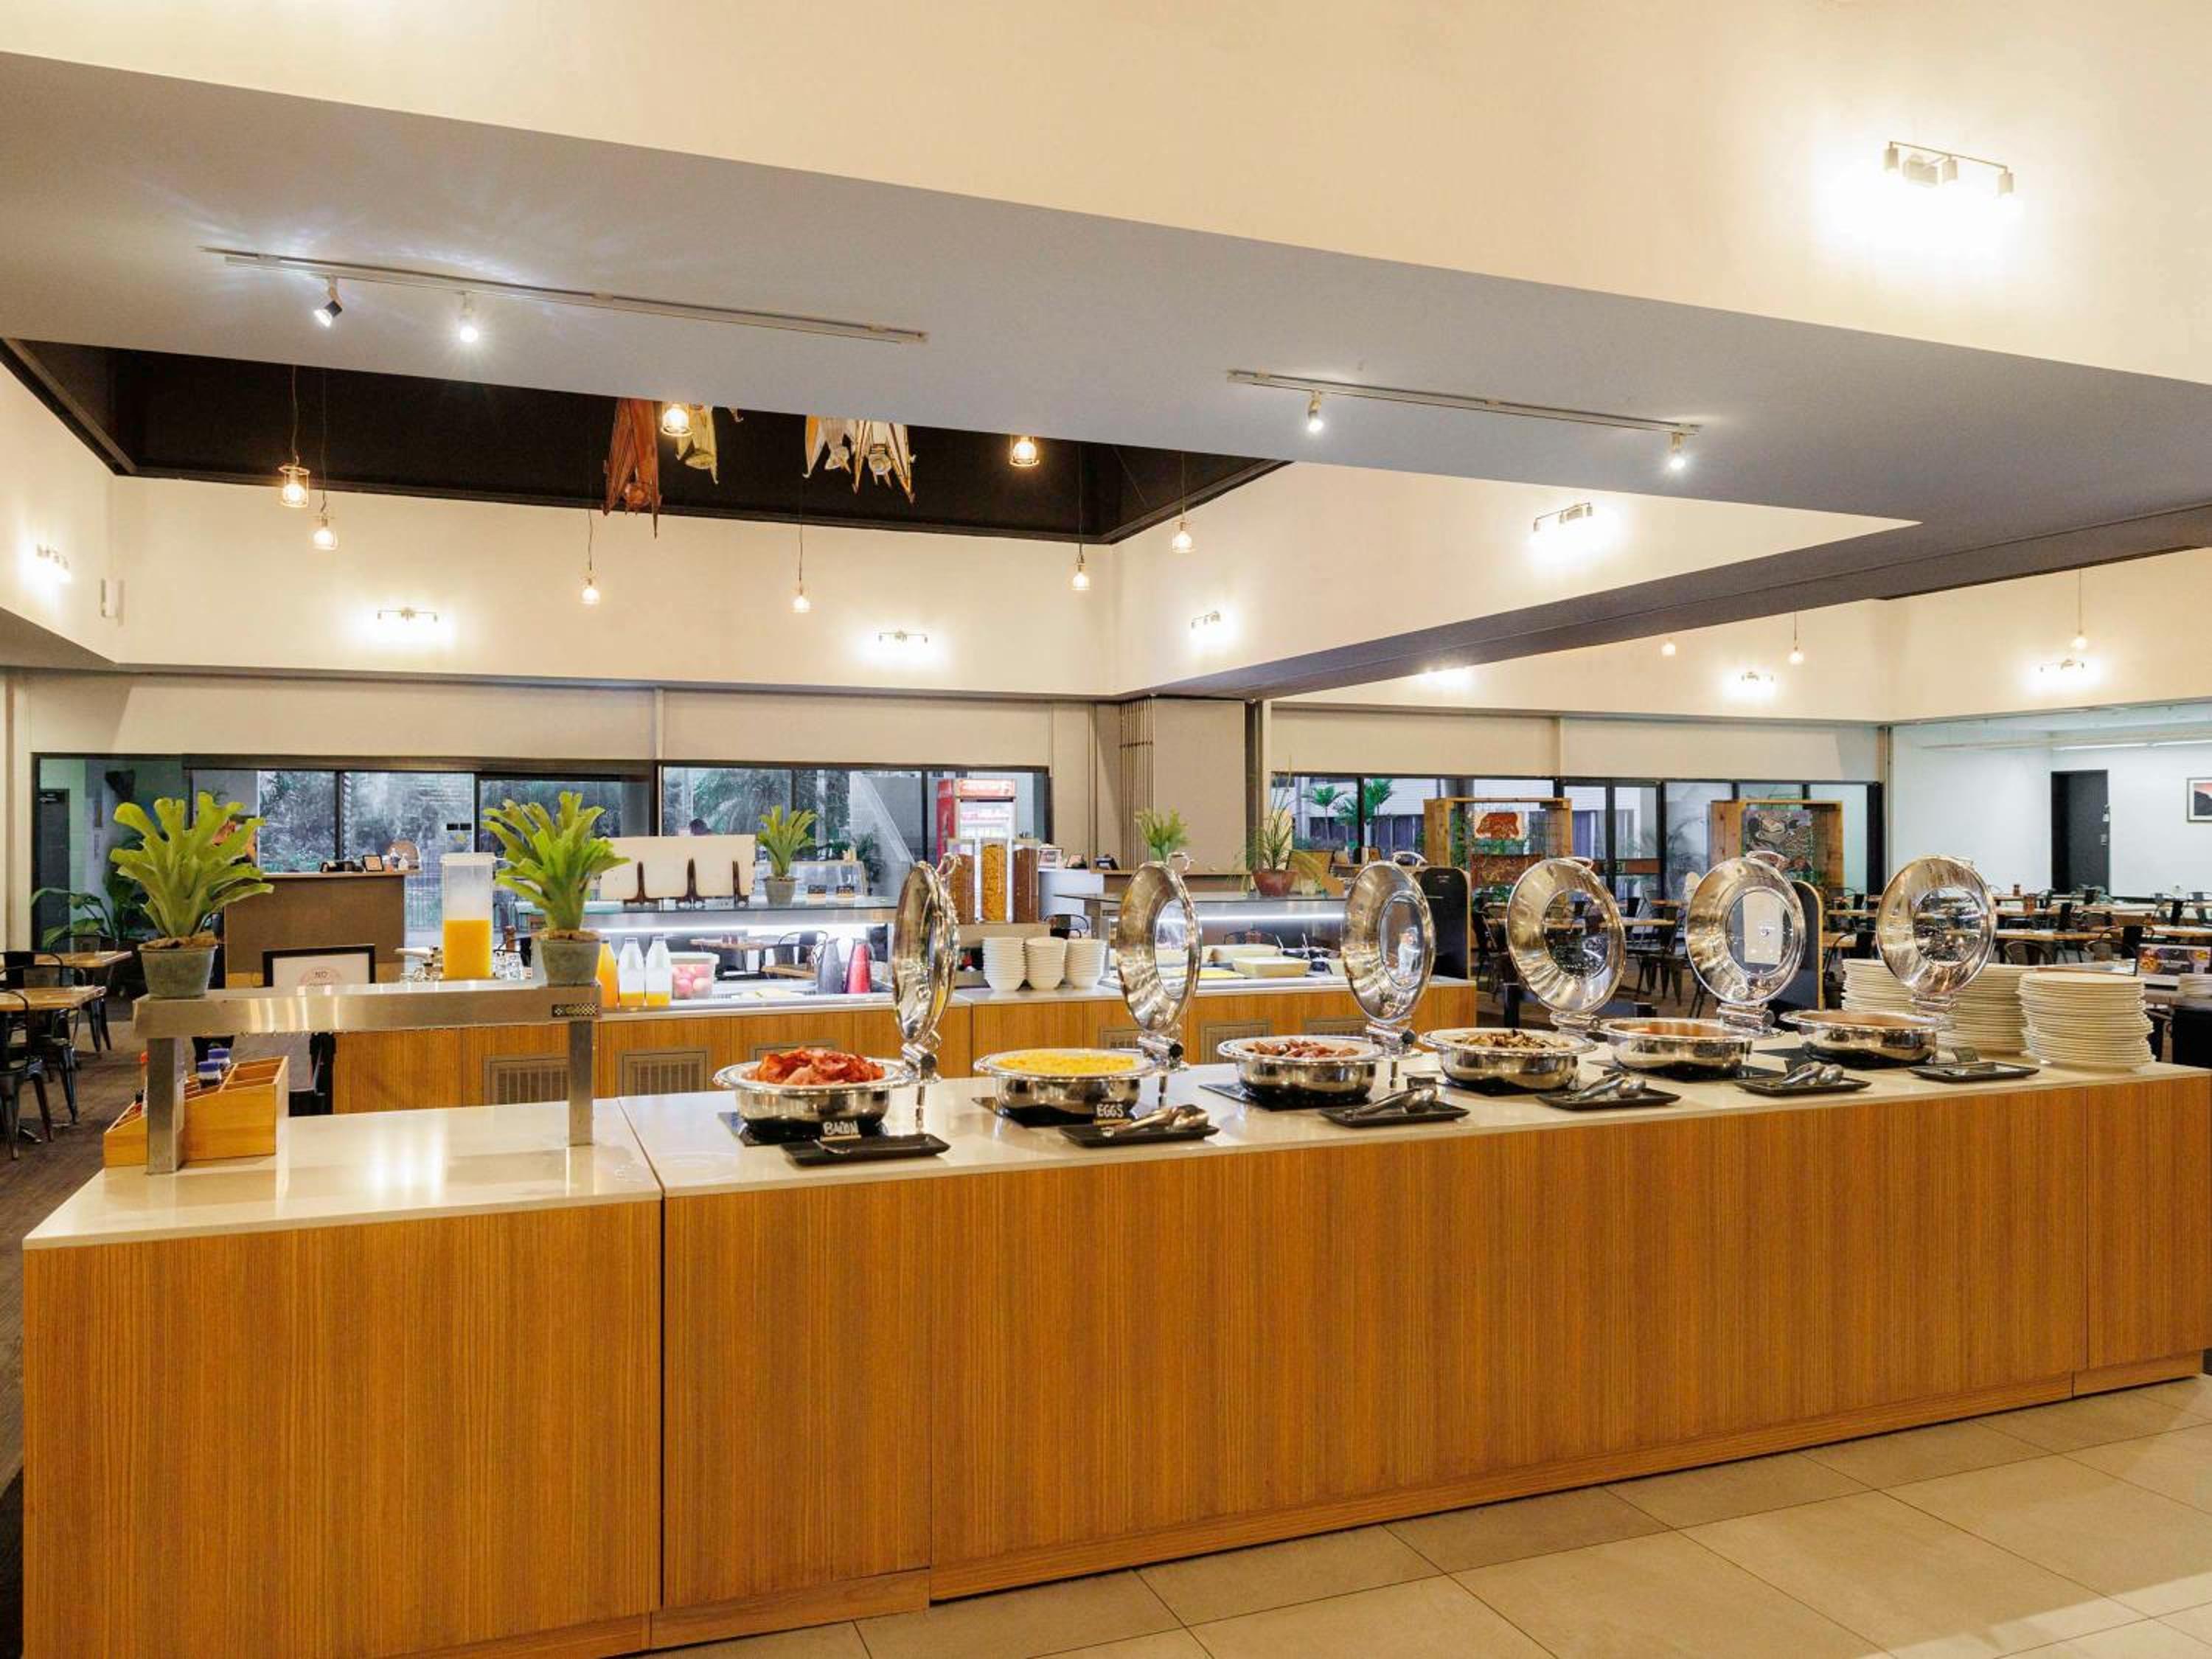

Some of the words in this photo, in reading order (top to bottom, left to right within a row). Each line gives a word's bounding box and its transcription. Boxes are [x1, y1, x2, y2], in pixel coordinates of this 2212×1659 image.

[315, 971, 328, 979] NO
[1096, 1104, 1124, 1117] EGGS
[823, 1121, 859, 1135] BACON
